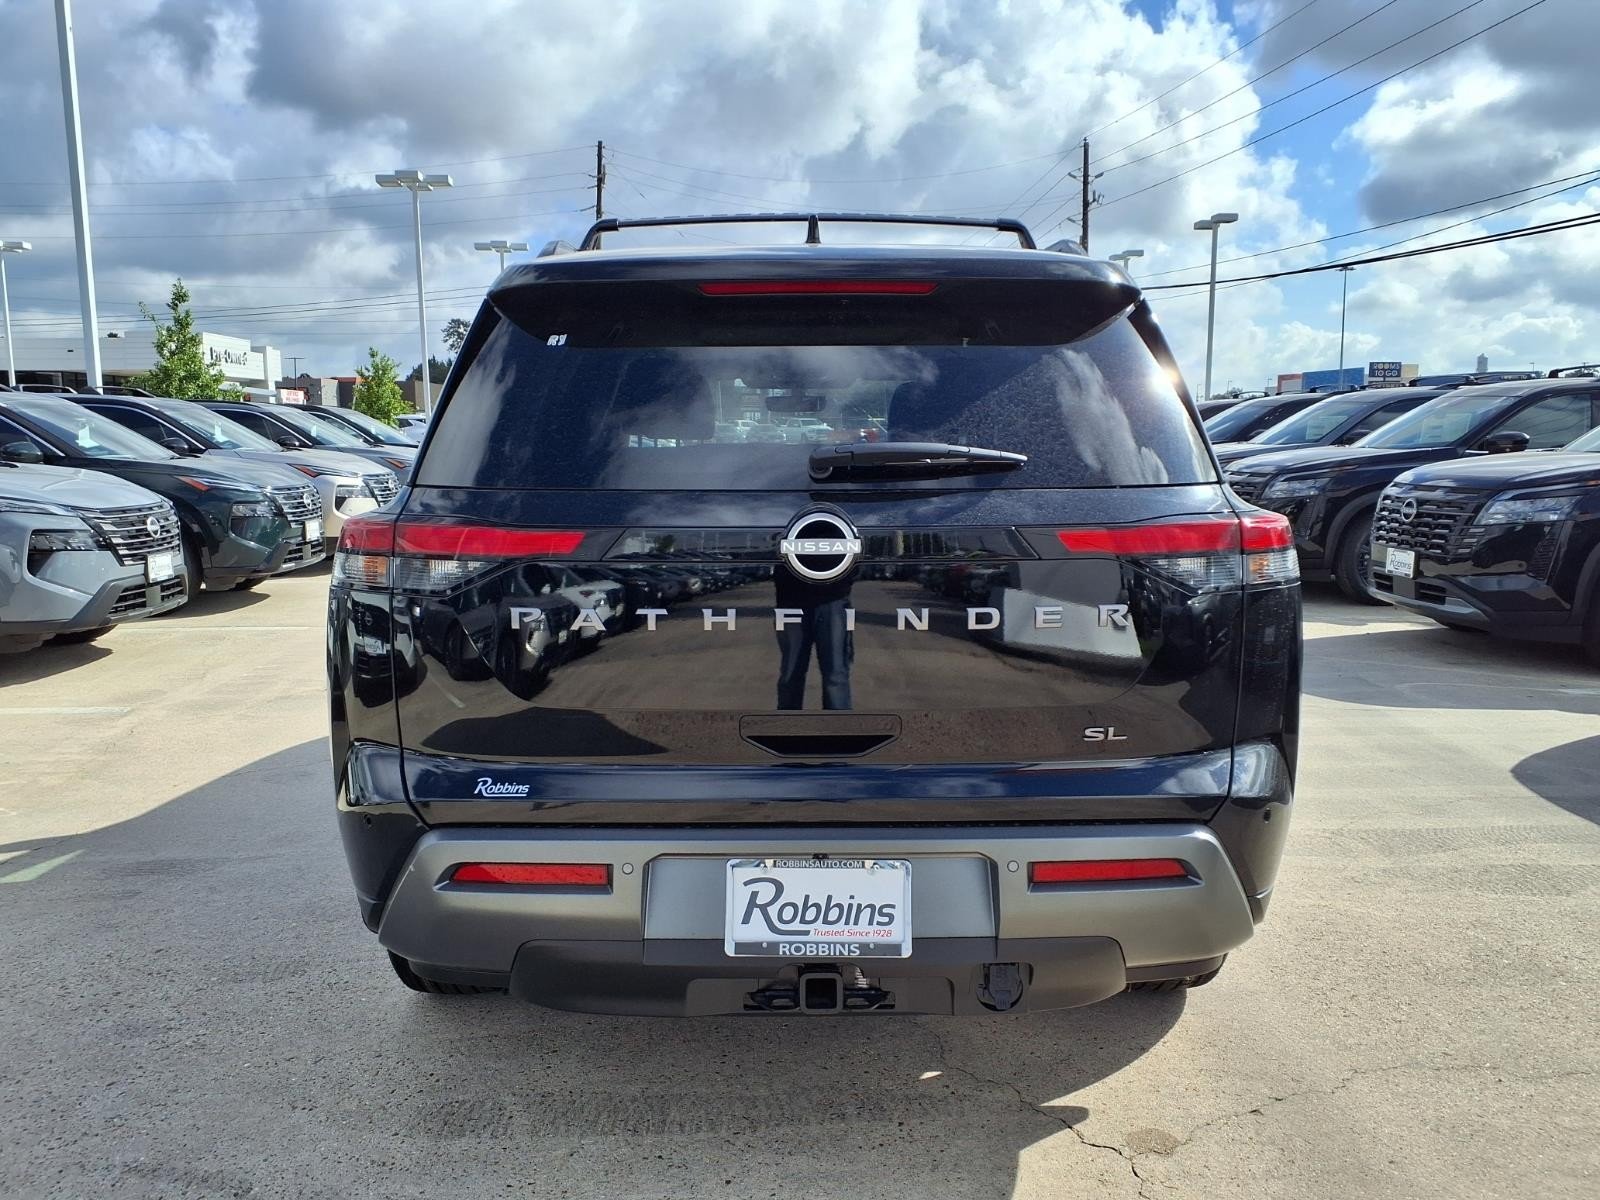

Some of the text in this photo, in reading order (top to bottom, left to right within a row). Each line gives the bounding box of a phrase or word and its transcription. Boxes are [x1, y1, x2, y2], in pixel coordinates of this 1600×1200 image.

[1373, 362, 1400, 370] ROOMS
[1375, 369, 1398, 377] TO GO
[783, 541, 859, 552] NISSAN
[509, 604, 1130, 632] PATHFINDER
[1083, 727, 1128, 742] SL
[474, 777, 530, 797] Robbins
[776, 860, 863, 869] ROBBINSAUTO.COM
[741, 877, 896, 936] Robbins
[813, 928, 892, 938] Trusted Since 1928
[779, 943, 861, 956] ROBBINS
